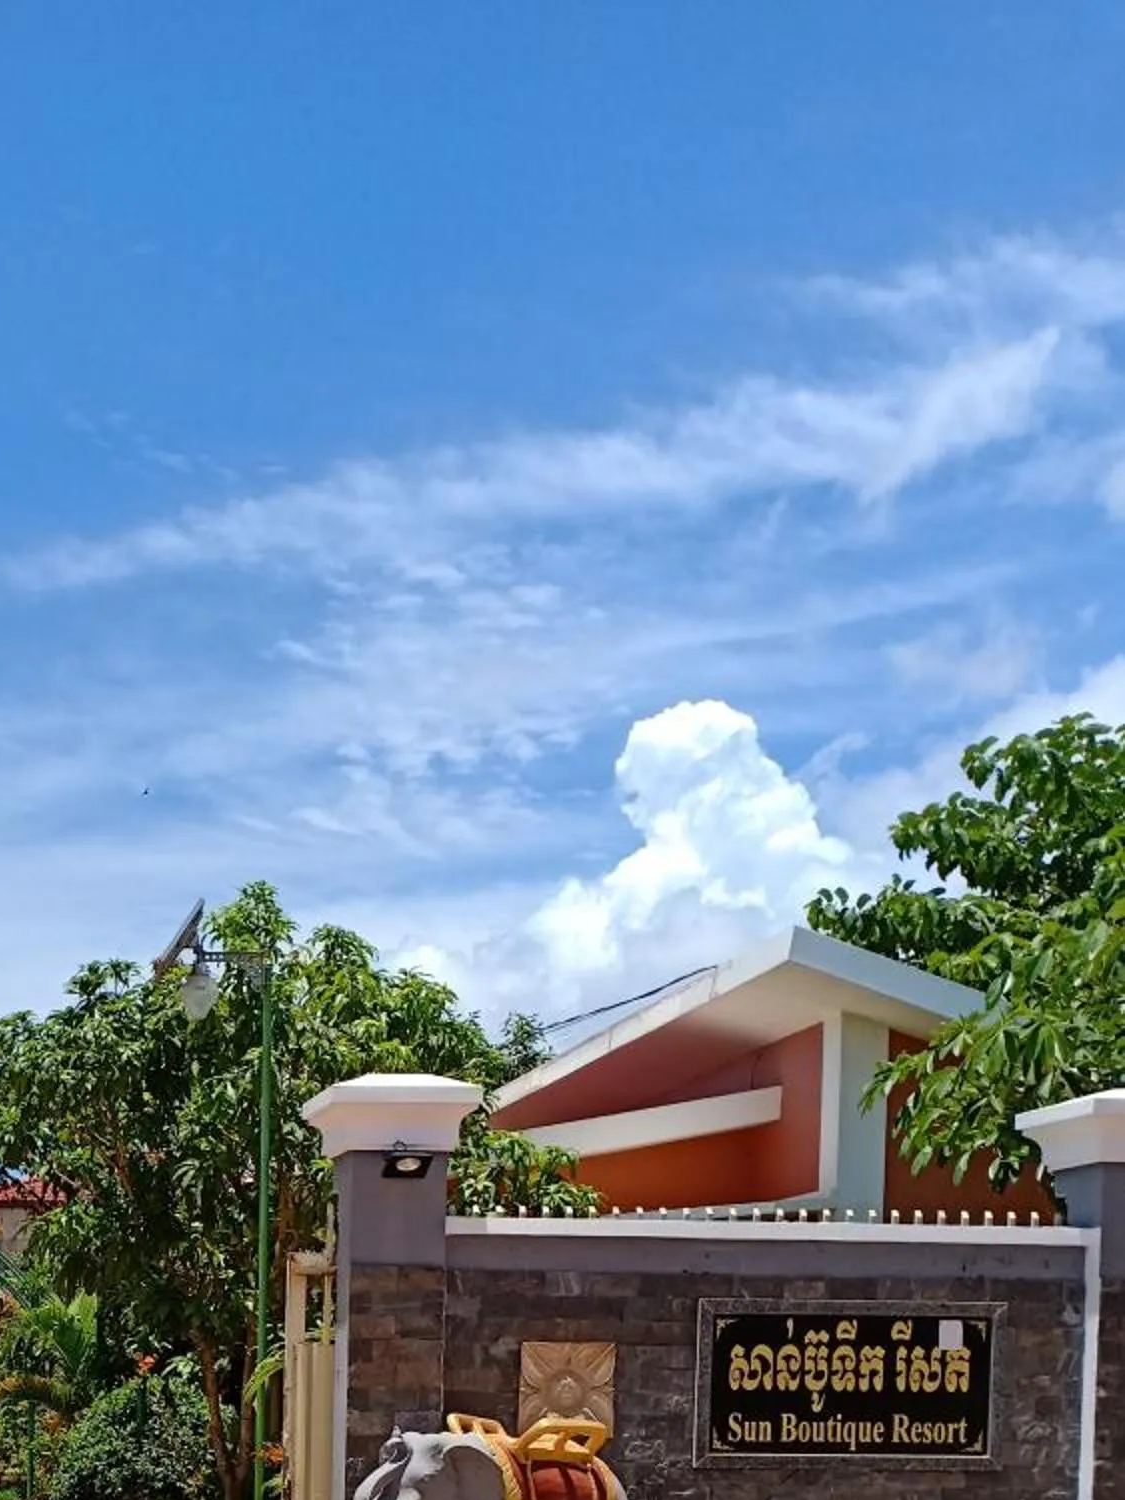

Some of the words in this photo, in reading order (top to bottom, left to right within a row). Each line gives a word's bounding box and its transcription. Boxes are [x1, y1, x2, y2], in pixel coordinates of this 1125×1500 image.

[728, 1412, 772, 1443] Sun
[780, 1413, 885, 1451] Boutique
[892, 1413, 968, 1444] Resort
